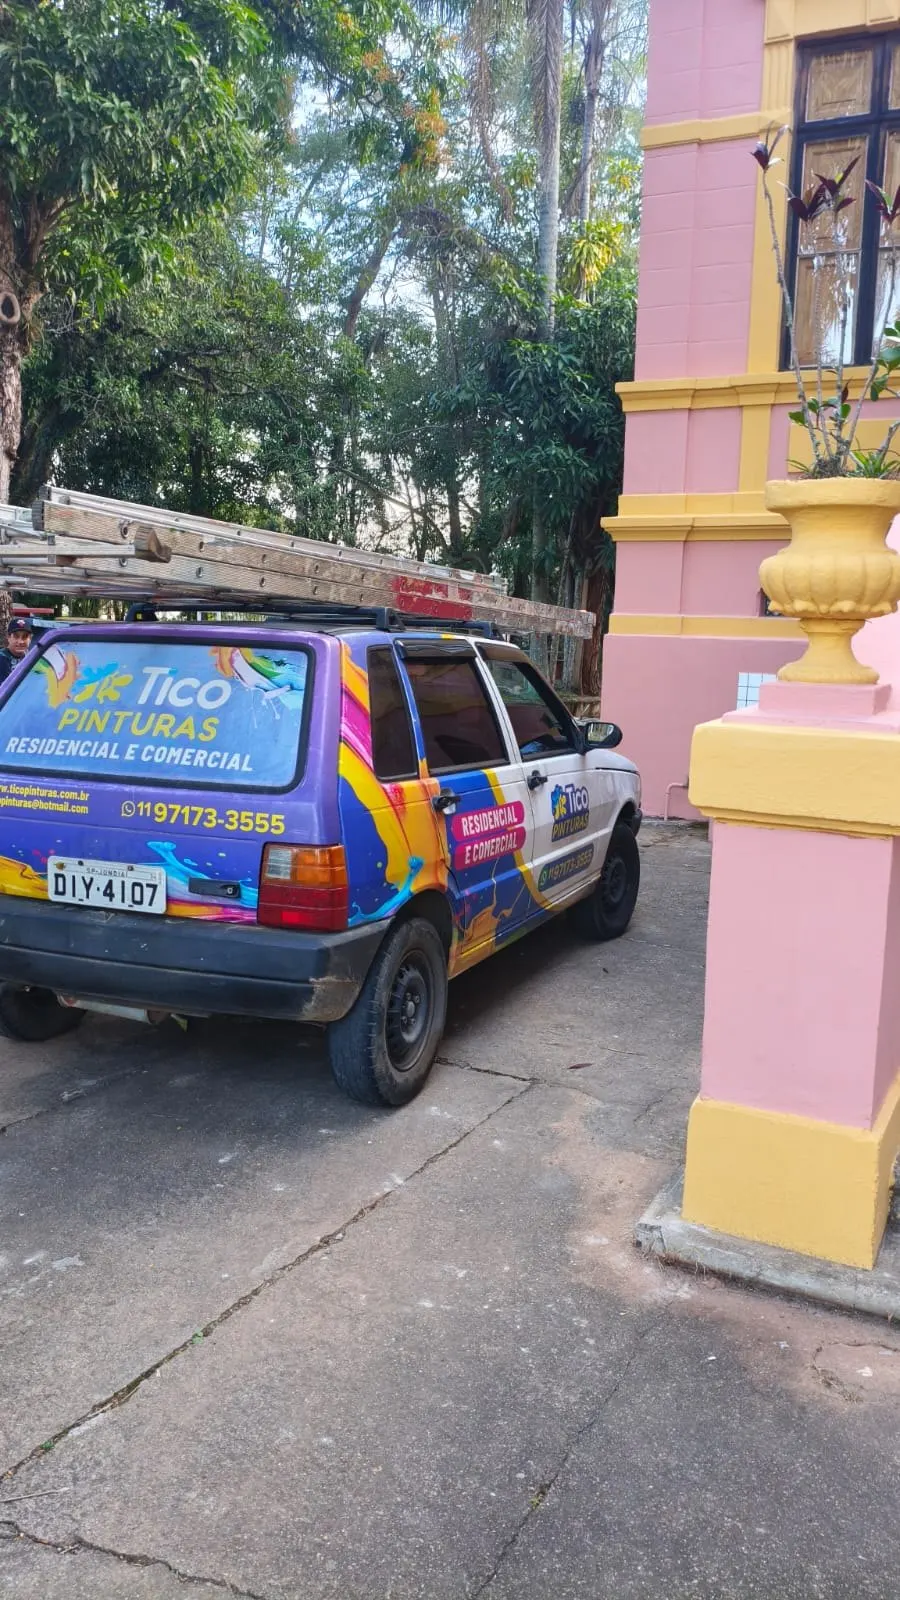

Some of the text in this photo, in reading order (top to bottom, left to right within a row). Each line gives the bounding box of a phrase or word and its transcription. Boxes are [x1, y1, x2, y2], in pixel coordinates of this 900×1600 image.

[58, 708, 220, 742] PINTURAS
[6, 737, 253, 772] RESIDENCIAL E COMERCIAL
[461, 805, 518, 837] RESIDENCIAL
[553, 813, 589, 837] PINTURAS
[465, 831, 518, 865] E COMERCIAL
